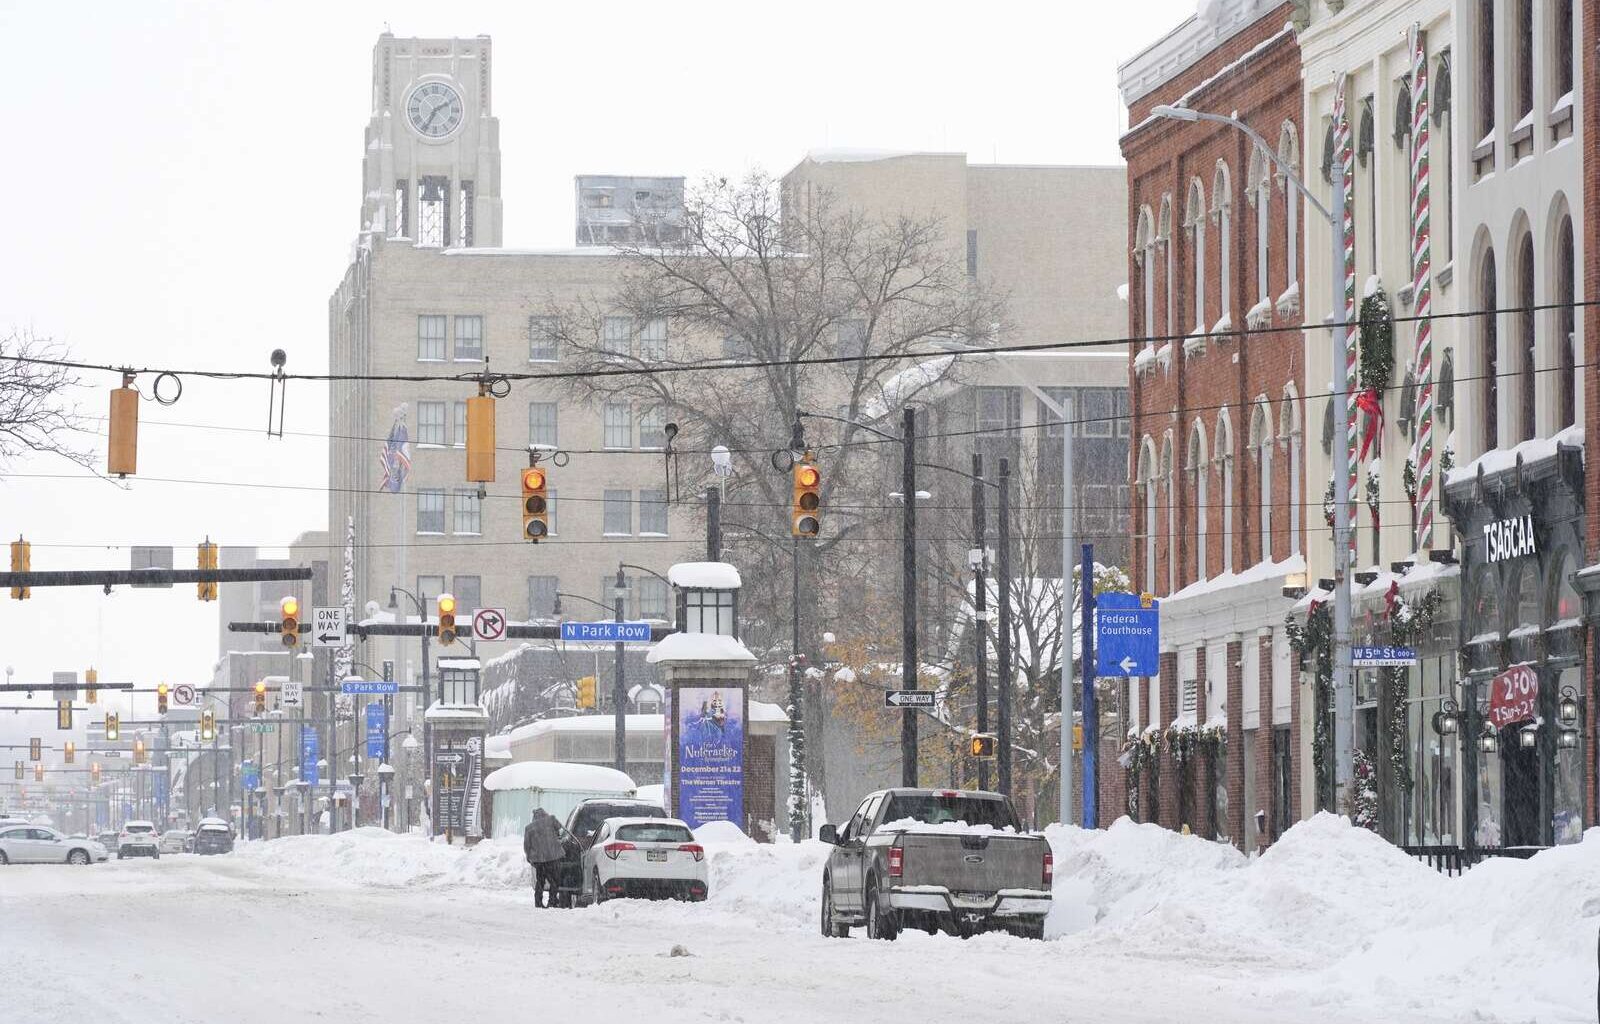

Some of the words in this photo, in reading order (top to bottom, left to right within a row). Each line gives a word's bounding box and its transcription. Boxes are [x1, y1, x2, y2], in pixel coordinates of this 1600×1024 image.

[318, 611, 339, 620] ONE
[1102, 614, 1138, 623] Federal
[317, 622, 340, 631] WAY
[567, 625, 575, 636] N
[582, 625, 611, 636] Park
[617, 626, 645, 637] Row
[1101, 626, 1152, 635] Courthouse
[1353, 649, 1363, 659] W
[1365, 648, 1381, 659] 5th
[1383, 648, 1396, 658] St
[346, 683, 352, 692] S
[354, 683, 373, 691] Park
[376, 683, 394, 692] Row
[1503, 677, 1514, 700] 2
[685, 744, 738, 758] Nutcracker
